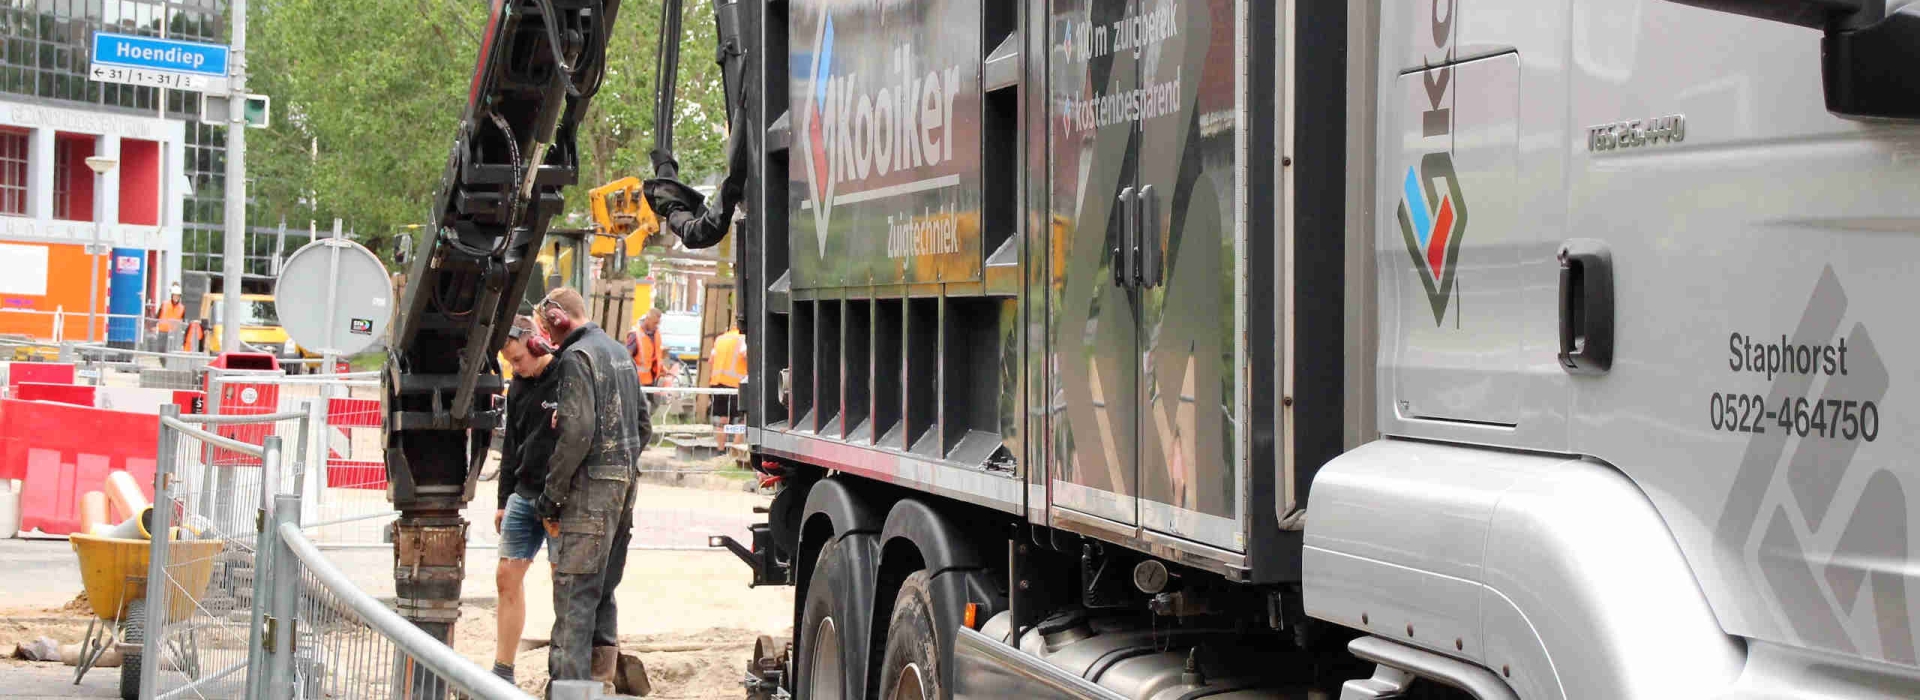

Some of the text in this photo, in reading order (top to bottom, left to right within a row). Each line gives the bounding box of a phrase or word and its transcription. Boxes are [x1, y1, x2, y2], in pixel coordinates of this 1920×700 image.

[116, 41, 205, 69] Hoendiep
[1076, 21, 1093, 62] 100
[1113, 0, 1177, 60] zuigbereik
[109, 69, 122, 79] 31
[137, 72, 142, 81] 1
[157, 74, 170, 84] 31
[1076, 65, 1180, 132] kostenbesparend
[837, 43, 960, 182] Kooiker
[887, 203, 959, 270] Zuigtechniek
[1729, 332, 1848, 381] Staphorst
[1710, 392, 1879, 442] 0522-464750
